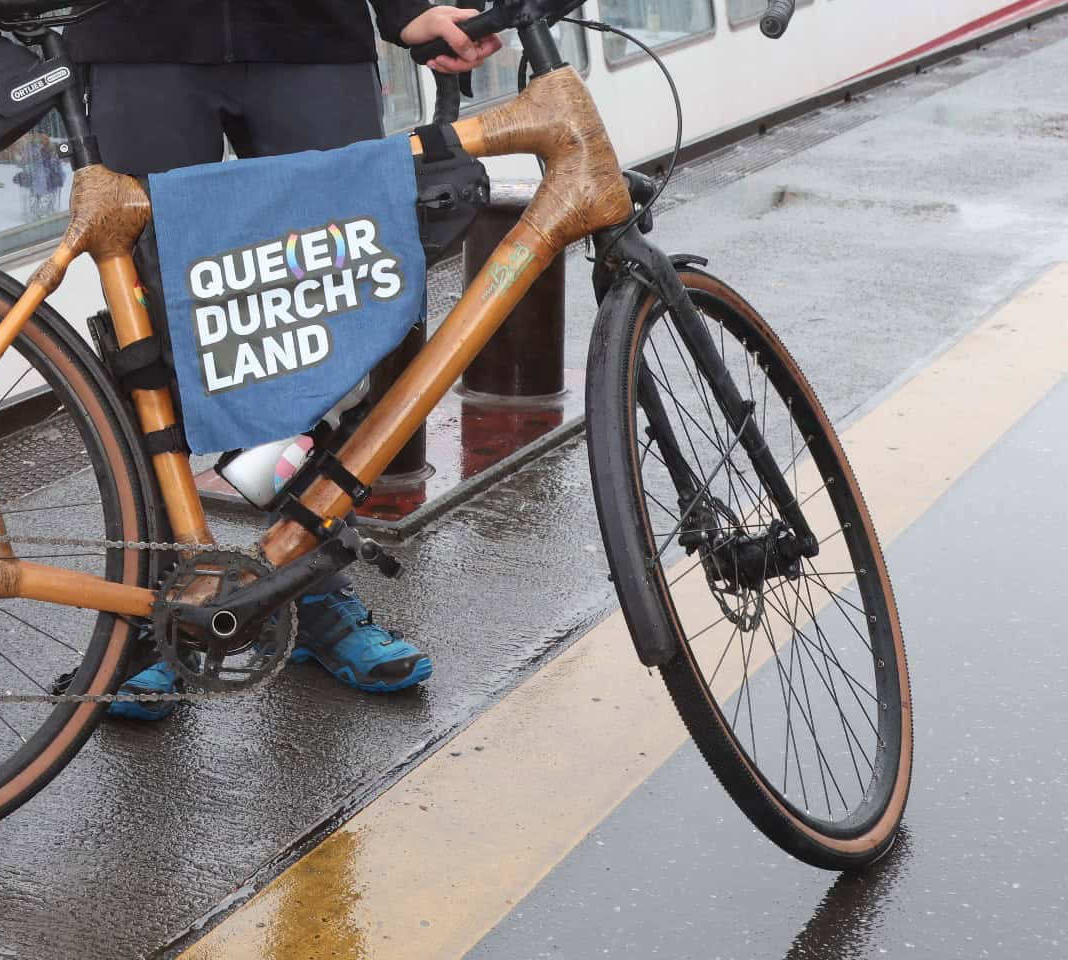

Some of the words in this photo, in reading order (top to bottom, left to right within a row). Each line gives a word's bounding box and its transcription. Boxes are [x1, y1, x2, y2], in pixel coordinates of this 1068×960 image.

[14, 80, 44, 98] ORTLIEB
[190, 219, 382, 299] QUE(E)R
[195, 258, 401, 346] DURCH'S
[202, 324, 329, 392] LAND
